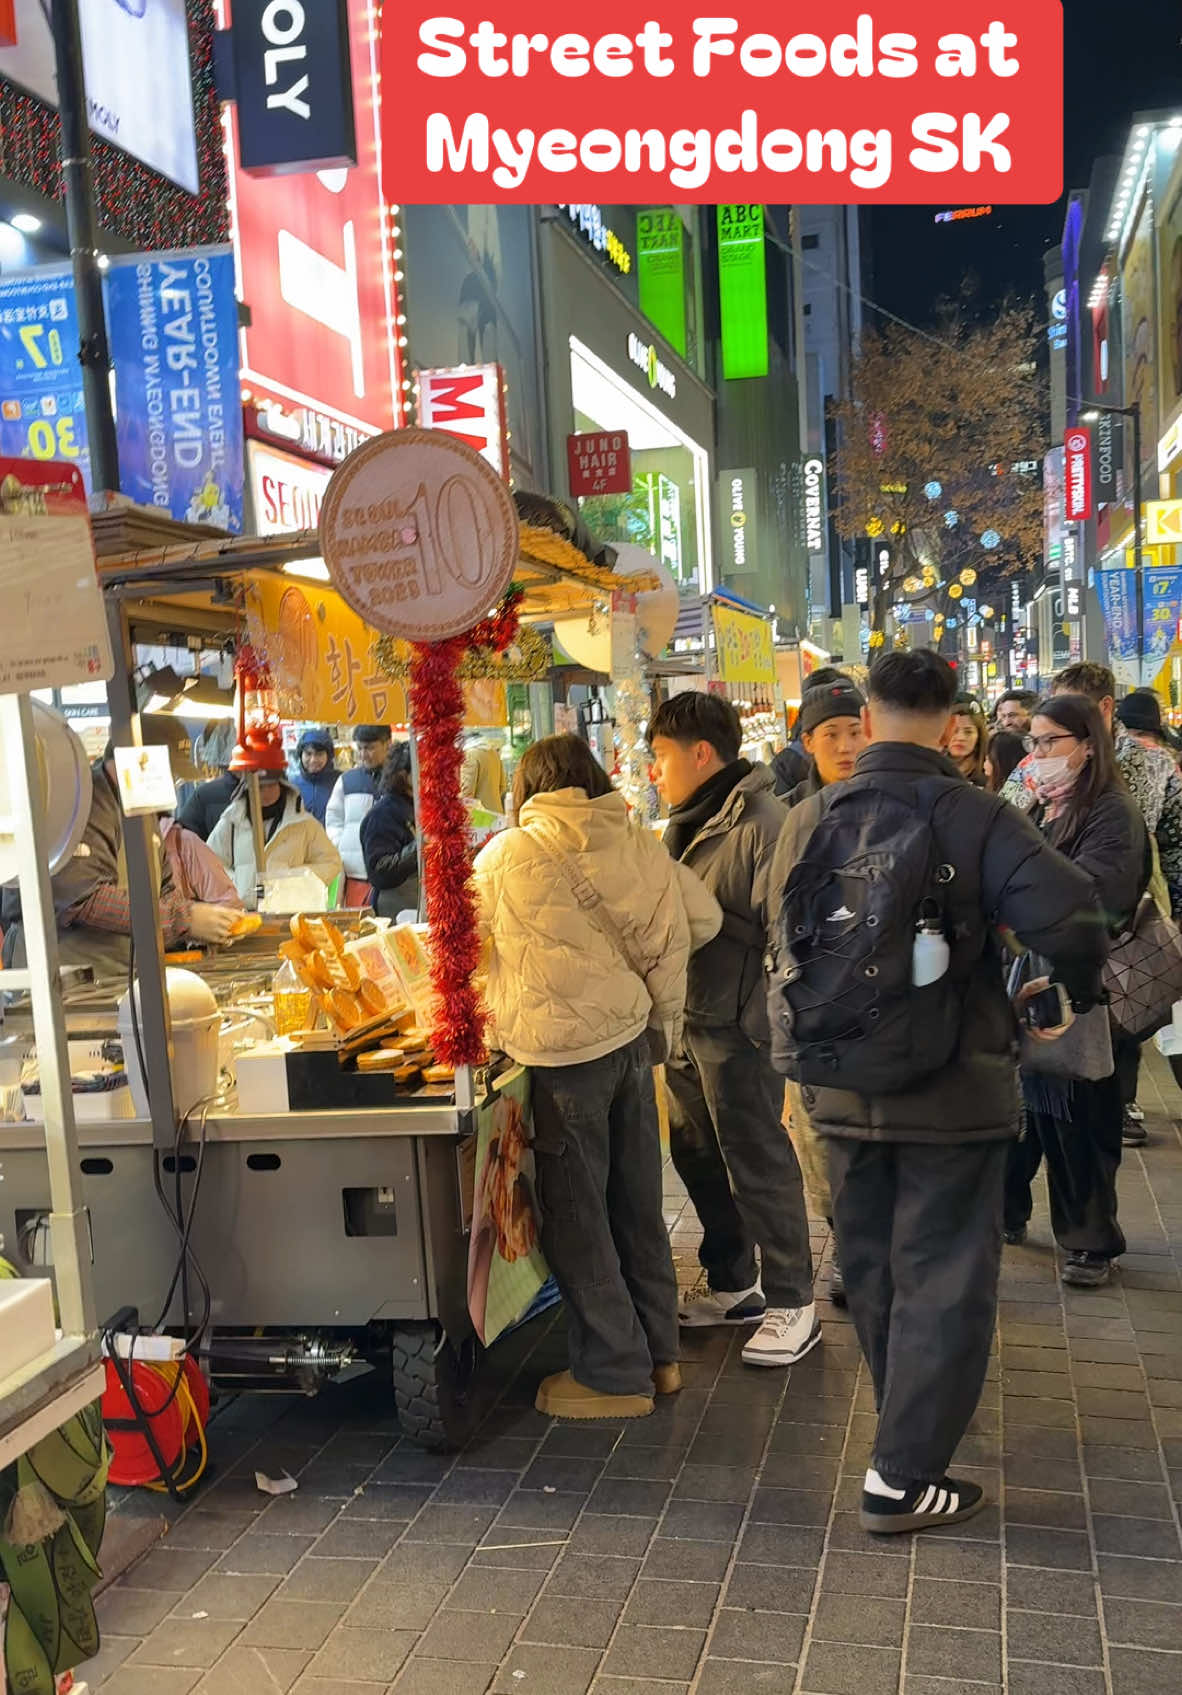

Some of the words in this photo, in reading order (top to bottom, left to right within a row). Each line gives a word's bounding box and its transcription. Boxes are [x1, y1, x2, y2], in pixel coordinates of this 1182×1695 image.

[721, 204, 760, 226] ABC
[574, 436, 621, 456] JUNO
[579, 451, 617, 470] HAIR
[731, 477, 744, 511] OLIVE
[804, 459, 823, 550] COVERNAT
[403, 473, 496, 596] 10
